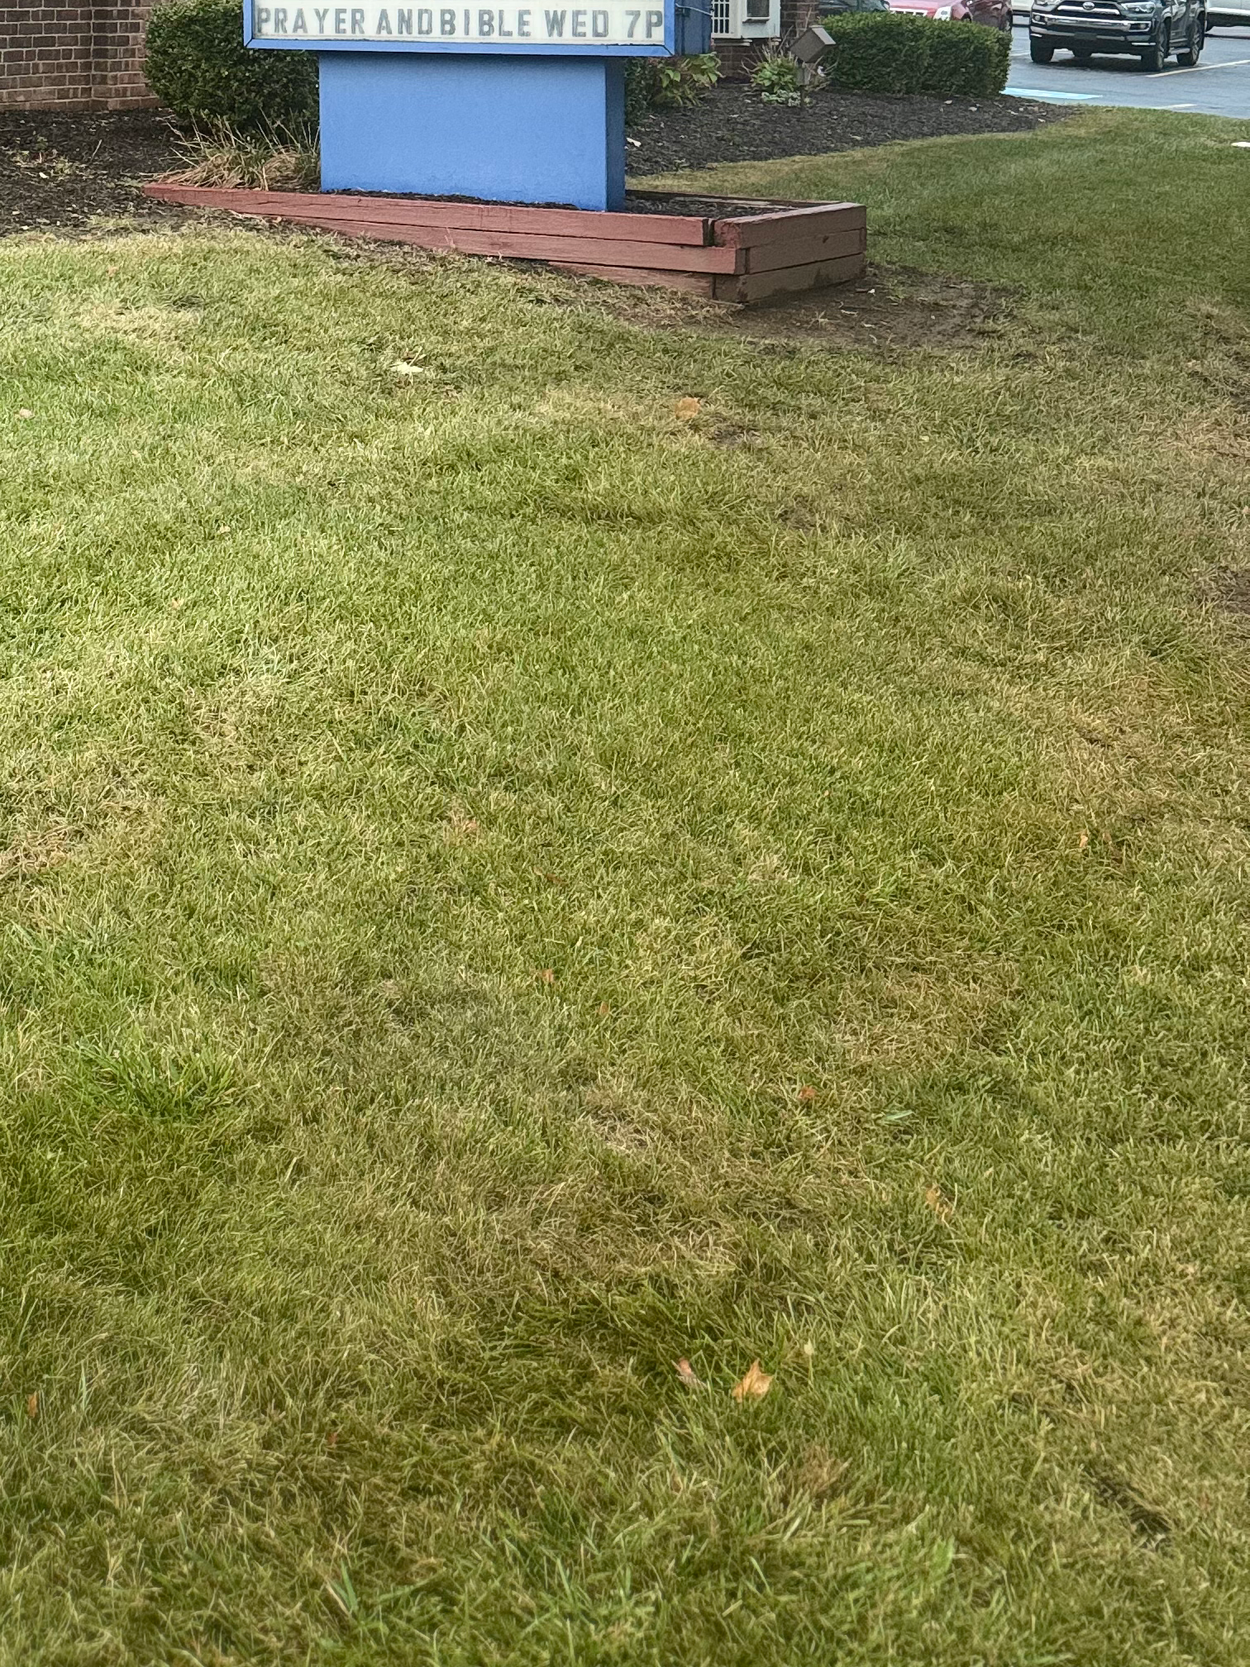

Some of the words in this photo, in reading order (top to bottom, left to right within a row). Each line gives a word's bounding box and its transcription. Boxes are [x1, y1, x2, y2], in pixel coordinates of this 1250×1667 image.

[257, 7, 366, 35] PRAYER
[544, 9, 610, 38] WED
[625, 9, 664, 39] 7P
